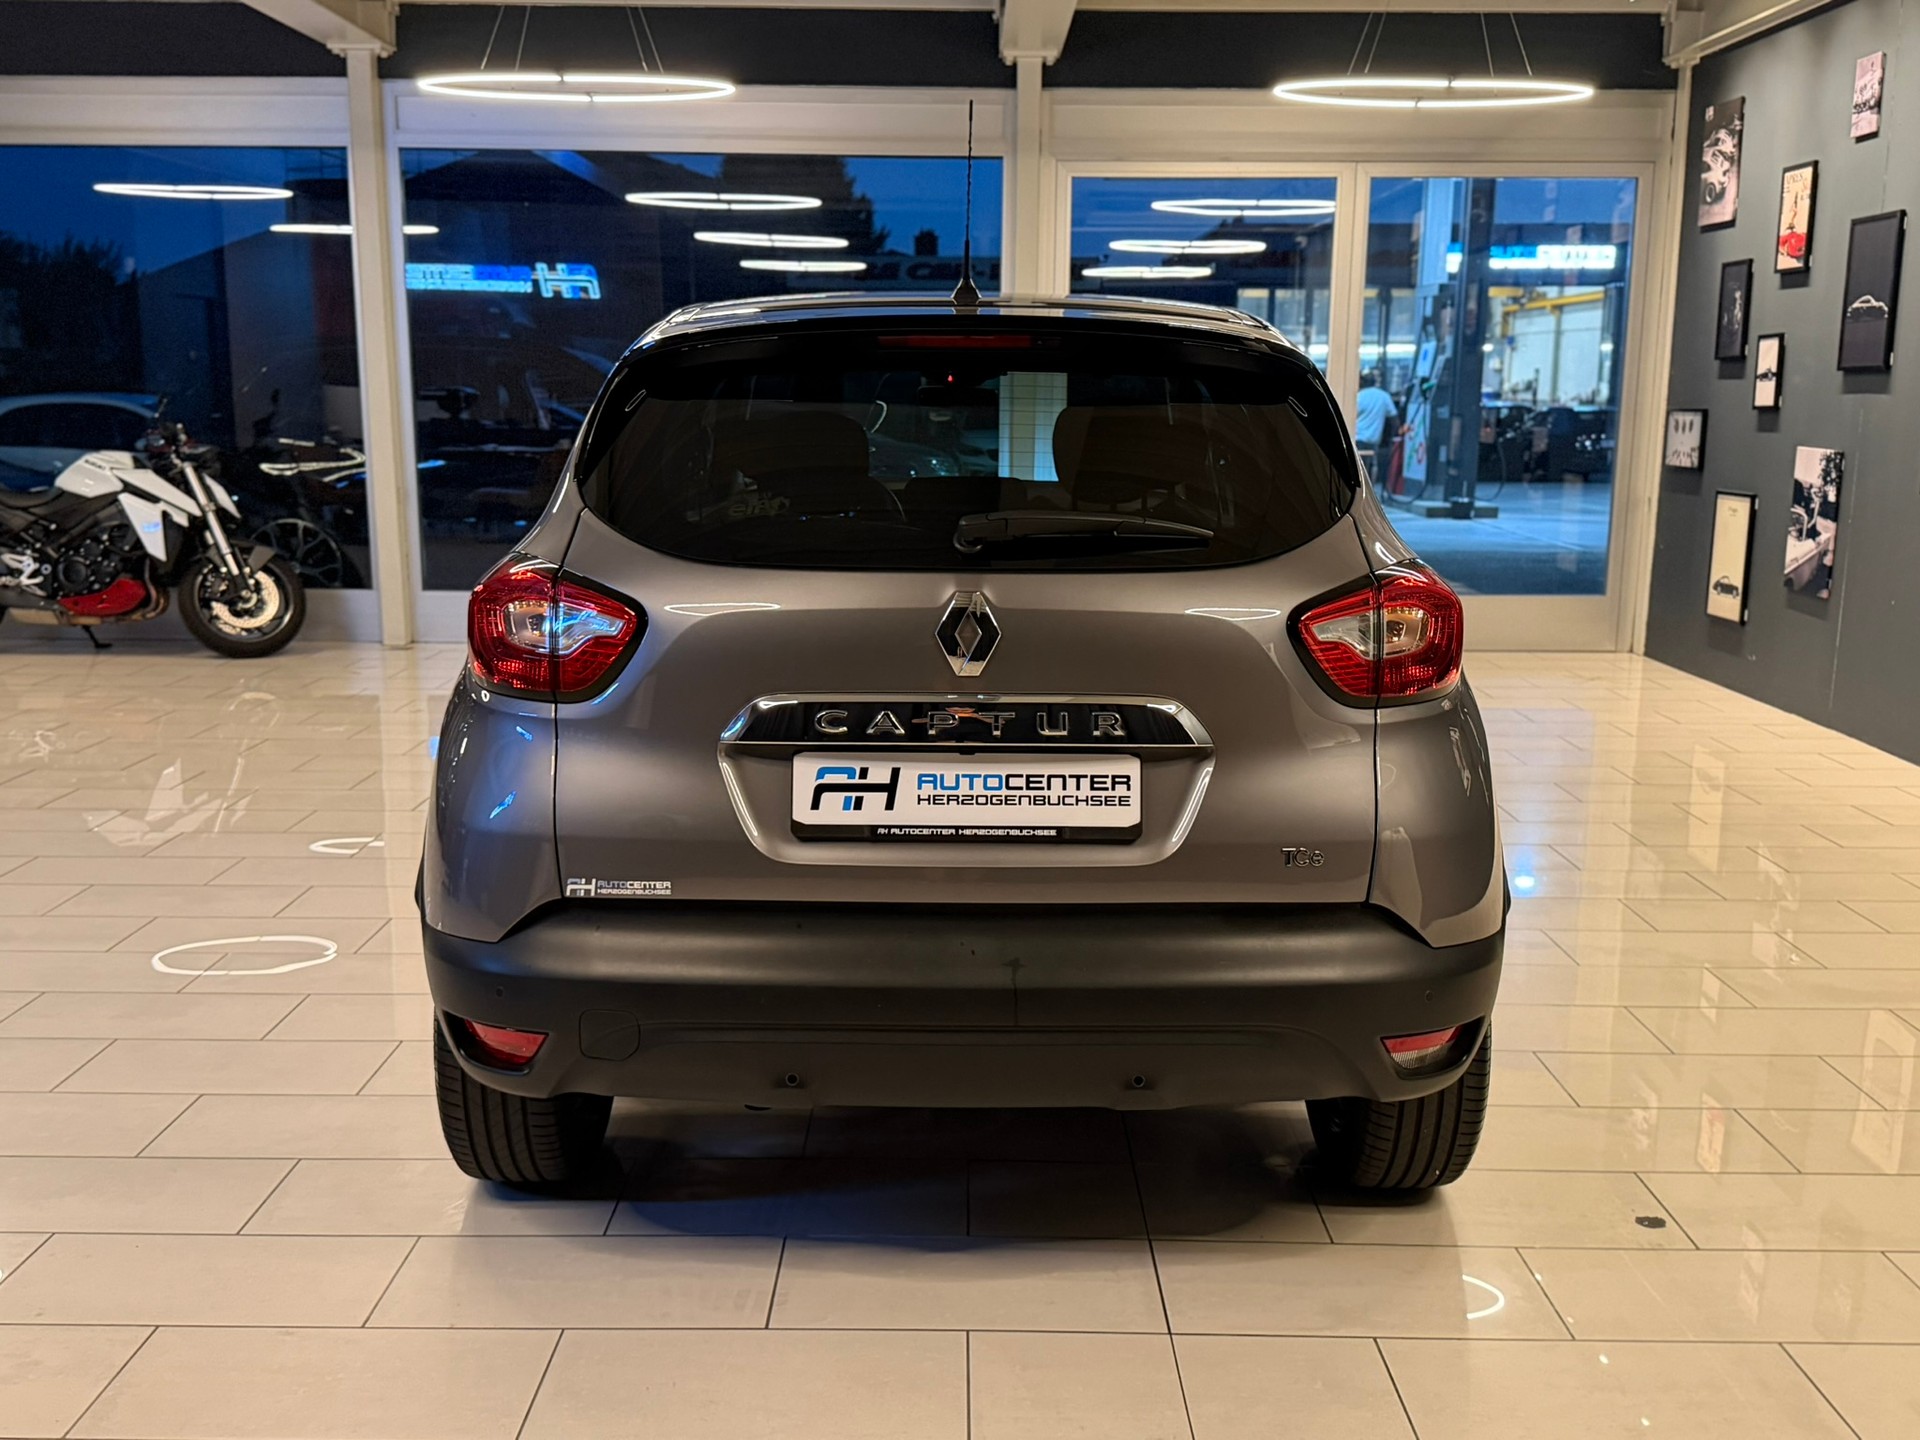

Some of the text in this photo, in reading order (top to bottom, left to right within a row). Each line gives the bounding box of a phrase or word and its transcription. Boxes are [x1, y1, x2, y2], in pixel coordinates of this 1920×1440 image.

[815, 709, 1126, 736] CAPTUR
[917, 773, 1131, 792] AUTOCENTER
[917, 794, 1131, 807] HERZOGENBUCHSEE
[890, 828, 956, 836] AUTOCENTER
[958, 828, 1058, 837] HERZOGENBUCHSEE
[1281, 847, 1324, 867] TCe
[597, 880, 671, 889] AUTOCENTER
